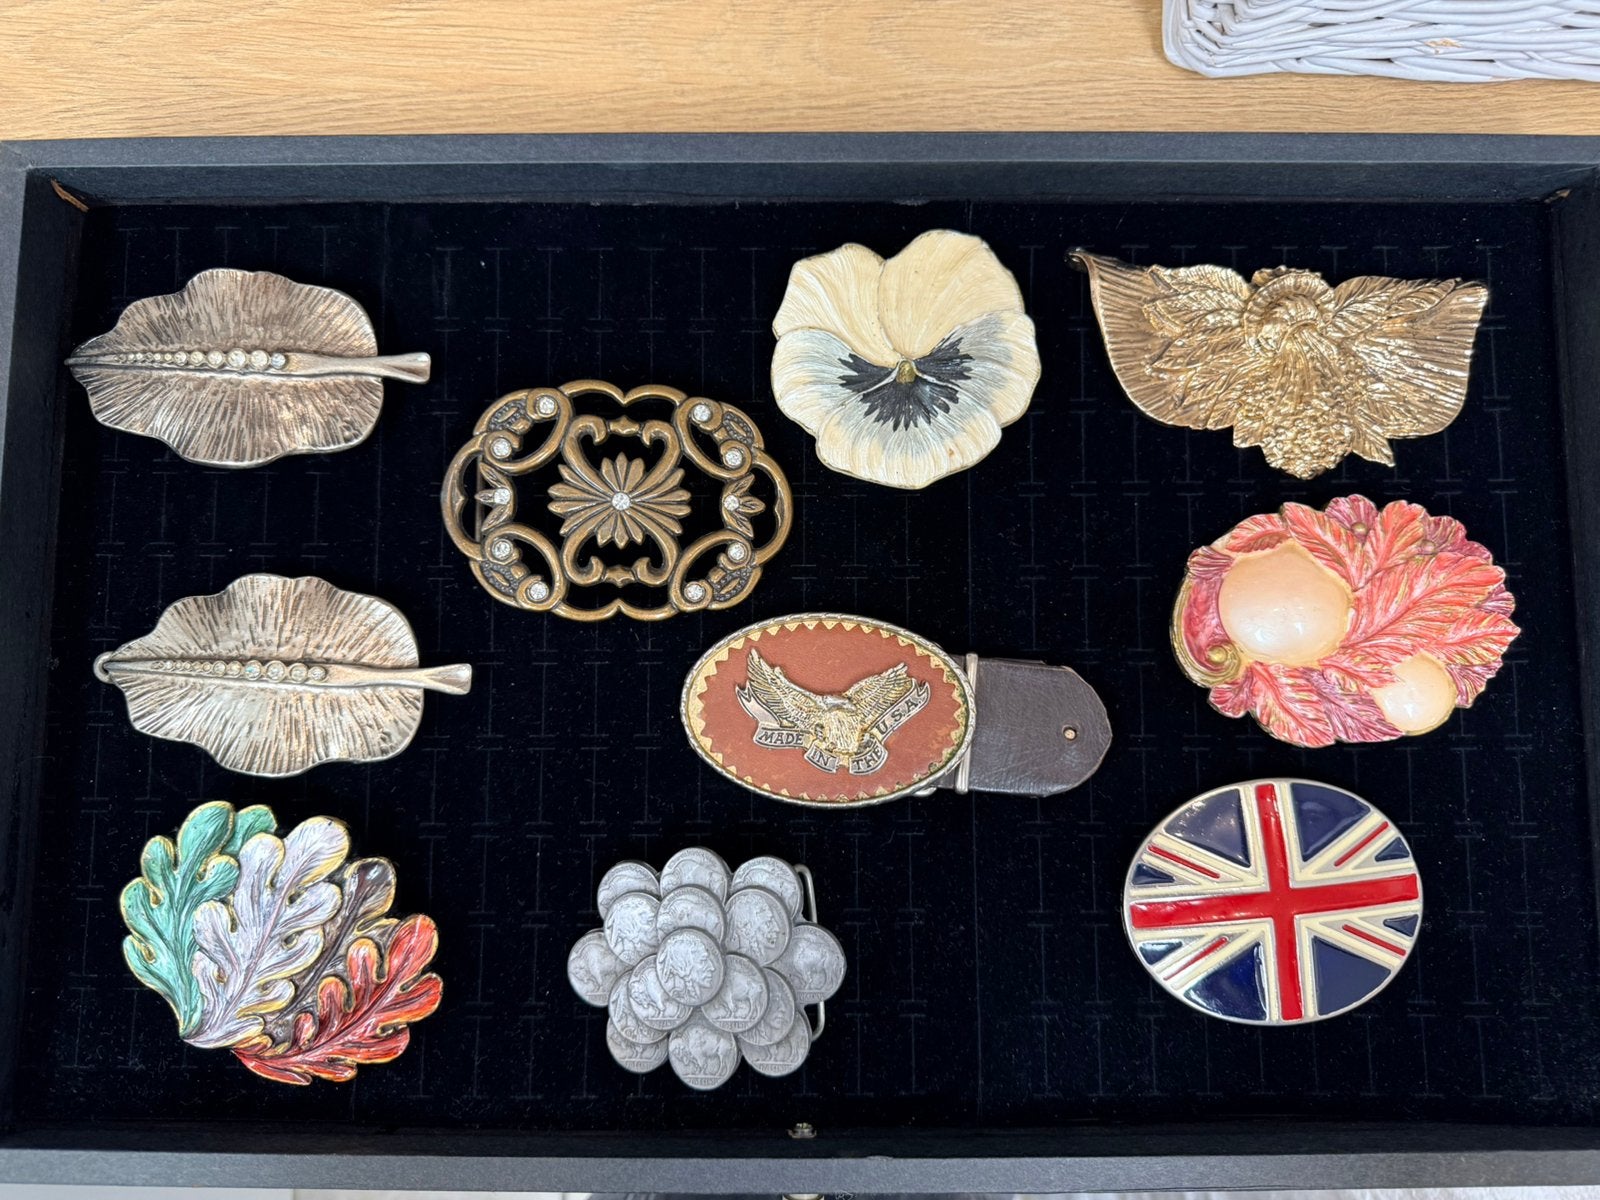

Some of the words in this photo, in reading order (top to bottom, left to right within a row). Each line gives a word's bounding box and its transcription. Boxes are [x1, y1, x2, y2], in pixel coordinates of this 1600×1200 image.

[758, 731, 804, 746] MADE
[810, 749, 831, 767] IN
[852, 747, 883, 771] THE
